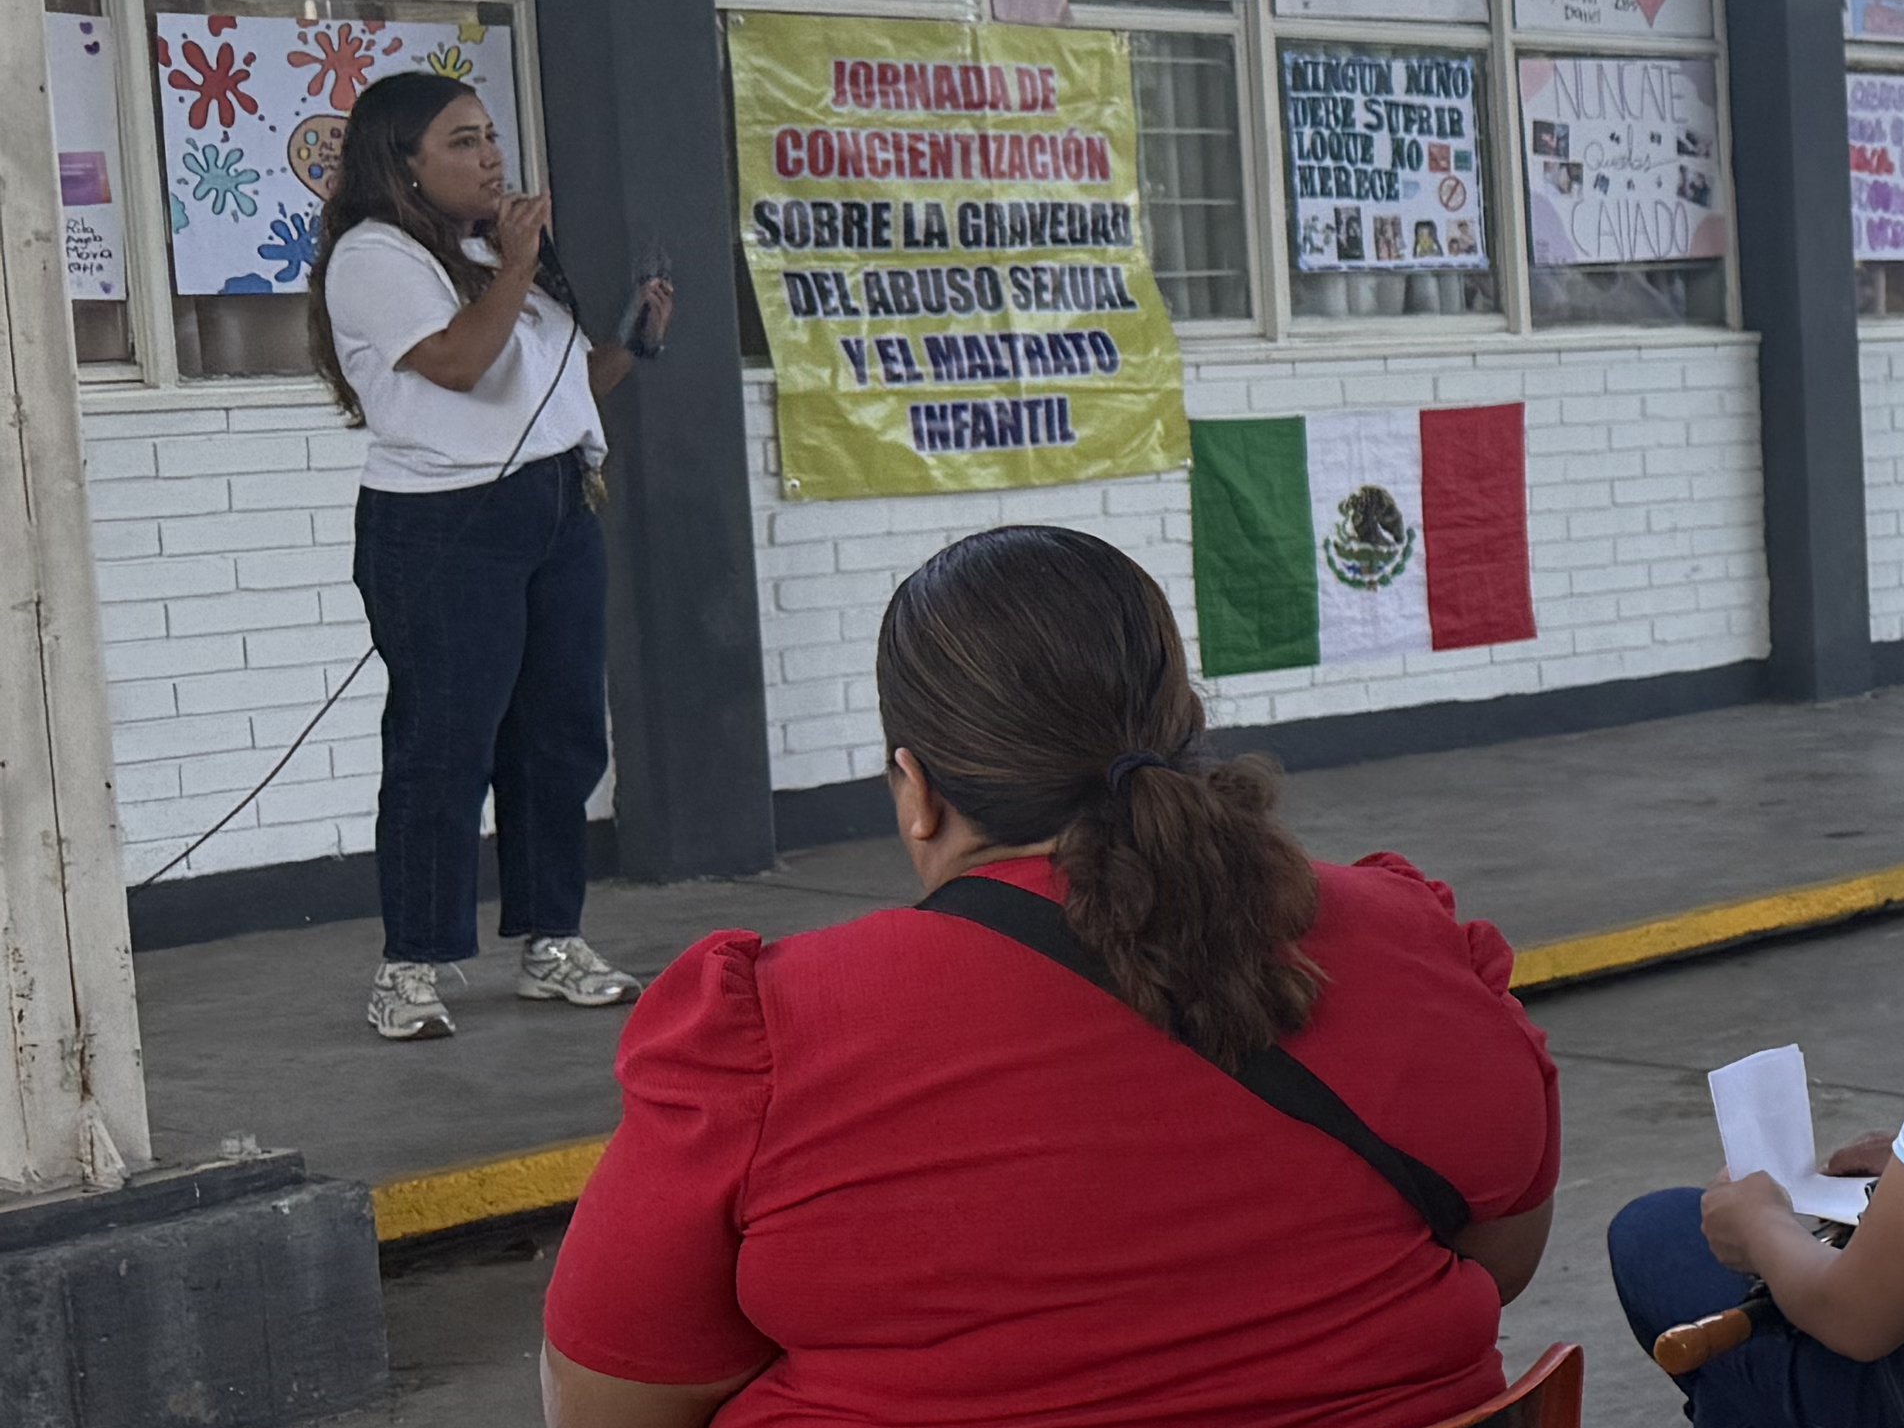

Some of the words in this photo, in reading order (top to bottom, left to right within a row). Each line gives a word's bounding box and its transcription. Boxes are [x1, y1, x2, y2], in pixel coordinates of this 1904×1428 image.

[831, 60, 1013, 113] JORNADA
[1015, 65, 1058, 114] DE
[1363, 98, 1466, 139] SUFRIR
[774, 125, 1112, 181] CONCIENTIZACIÓN
[1390, 137, 1424, 172] NO
[1297, 164, 1400, 202] MERECE
[752, 199, 893, 250] SOBRE
[902, 201, 949, 249] LA
[956, 200, 1134, 248] GRAVEDAD
[782, 271, 862, 318] DEL
[863, 266, 1005, 317] ABUSO
[1008, 265, 1140, 312] SEXUAL
[839, 337, 868, 385] Y
[874, 336, 924, 384] EL
[922, 330, 1121, 383] MALTRATO
[908, 395, 1078, 452] INFANTIL
